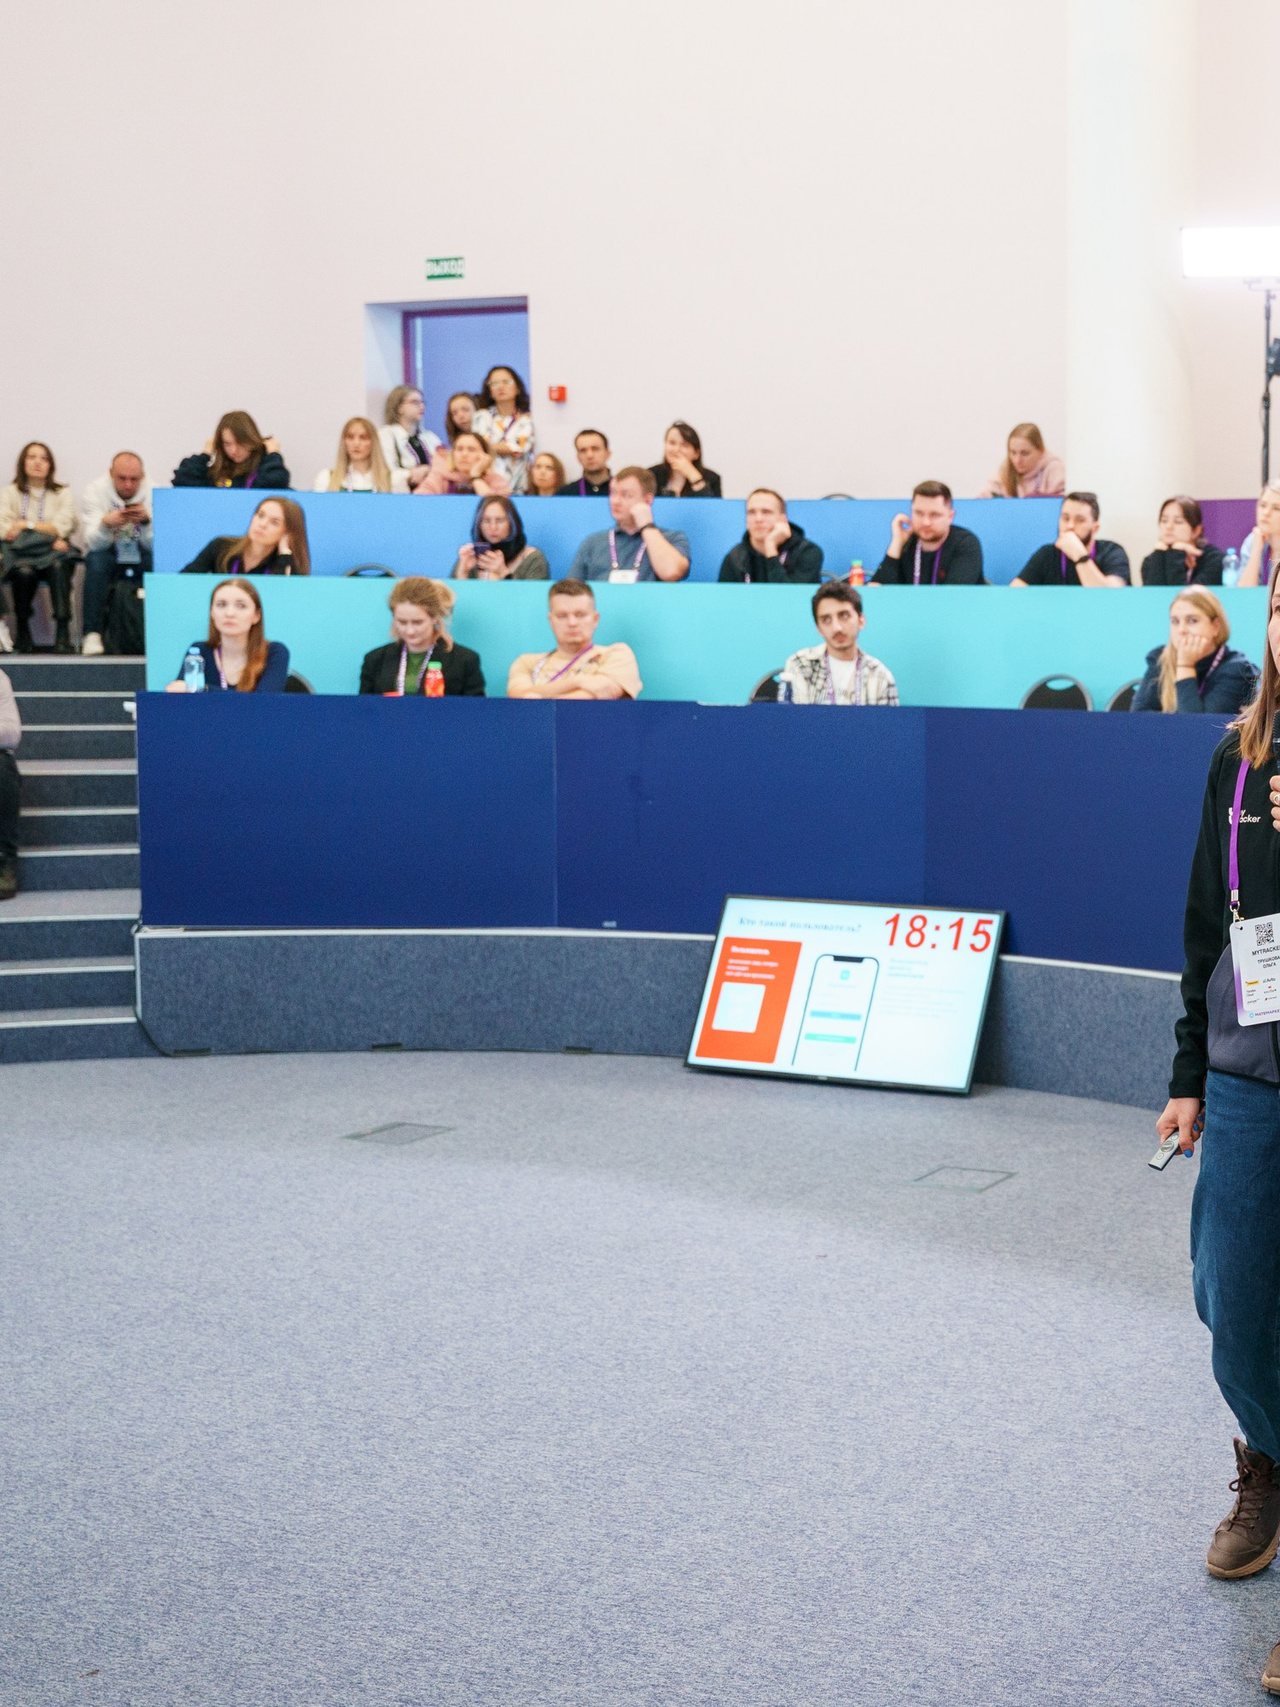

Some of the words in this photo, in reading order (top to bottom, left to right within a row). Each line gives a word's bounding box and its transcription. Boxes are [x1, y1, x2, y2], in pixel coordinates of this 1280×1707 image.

[427, 260, 465, 275] ВЫХОД
[1239, 814, 1261, 823] acker
[885, 913, 994, 953] 18:15
